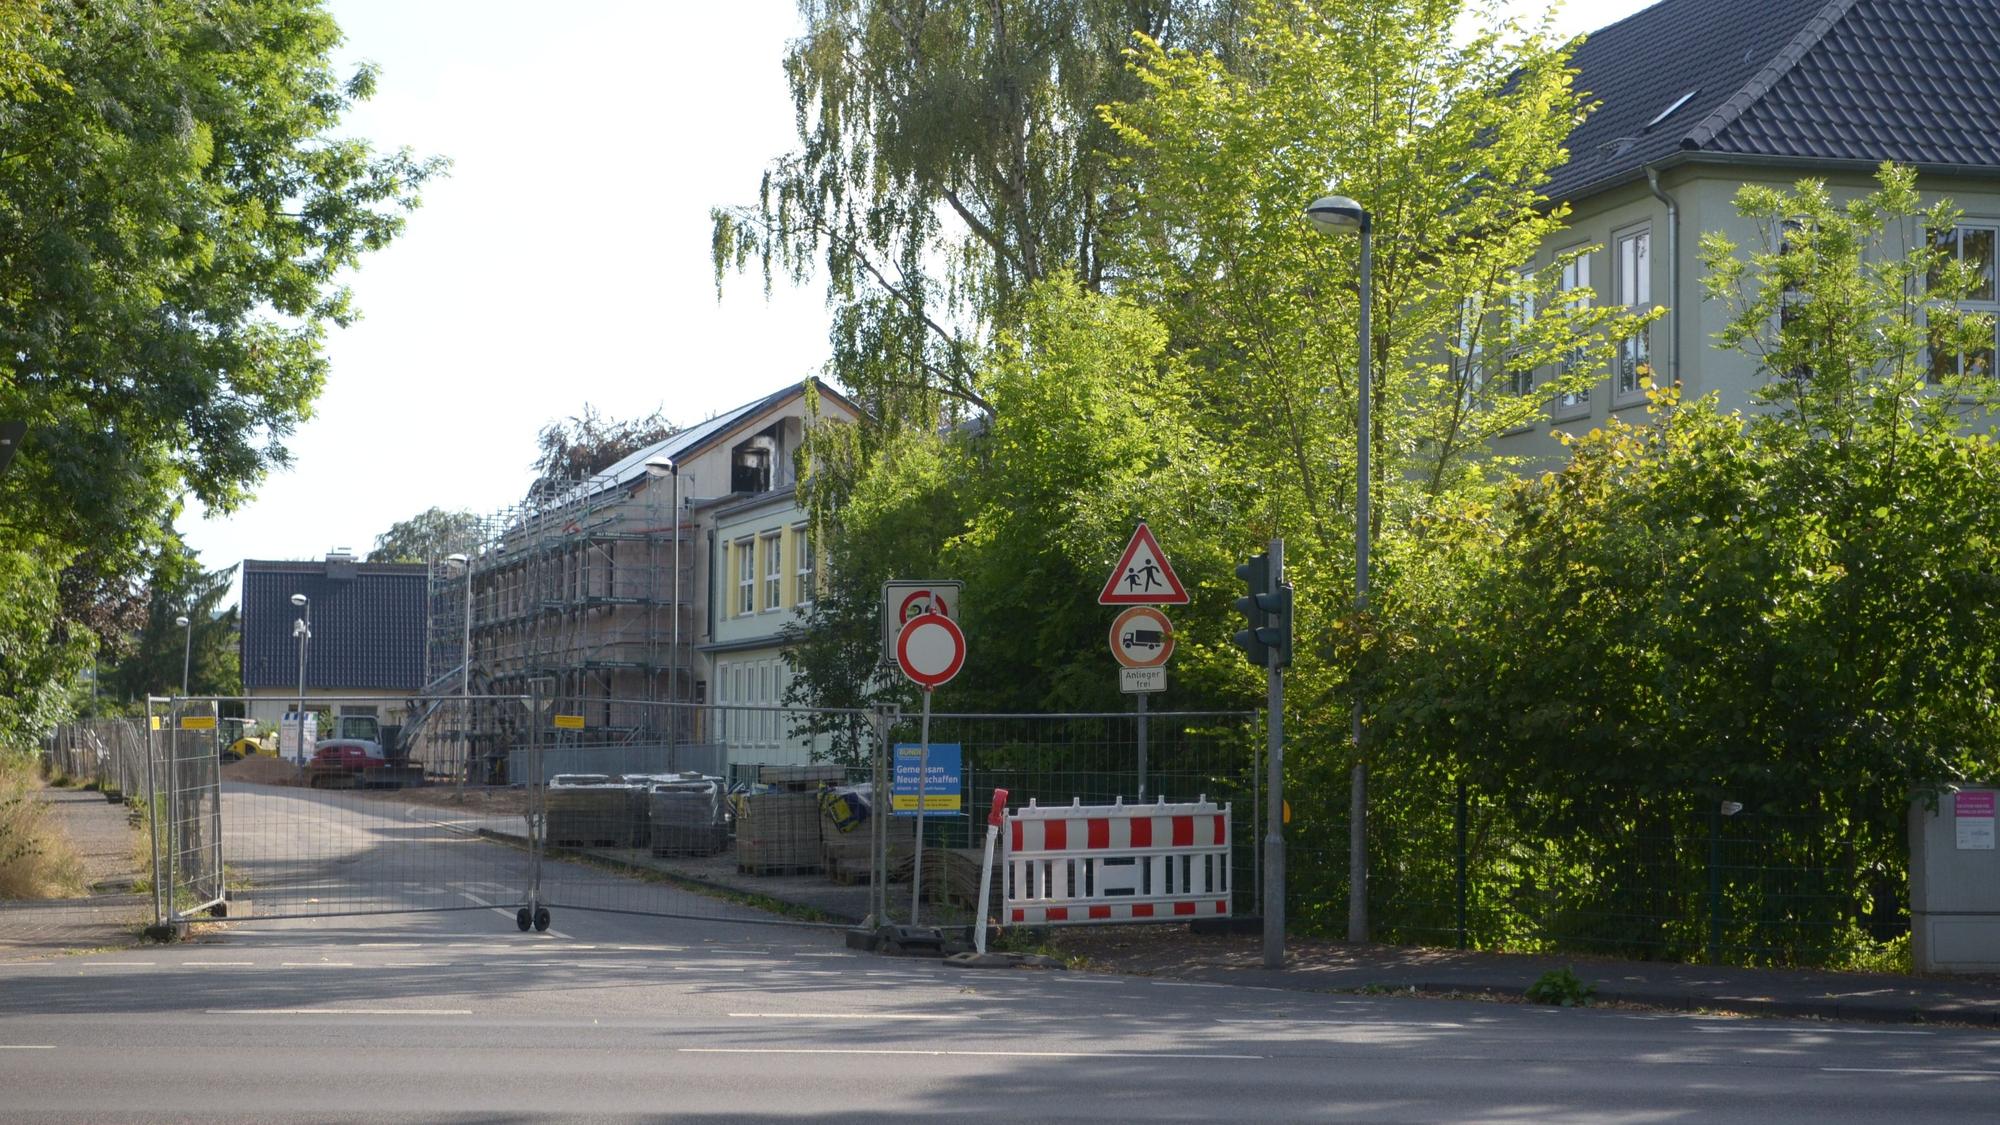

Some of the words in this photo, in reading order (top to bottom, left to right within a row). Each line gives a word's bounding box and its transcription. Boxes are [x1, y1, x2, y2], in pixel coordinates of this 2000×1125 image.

[1126, 671, 1161, 680] Anlieger
[1136, 680, 1151, 688] frei
[896, 765, 944, 773] Gemesam
